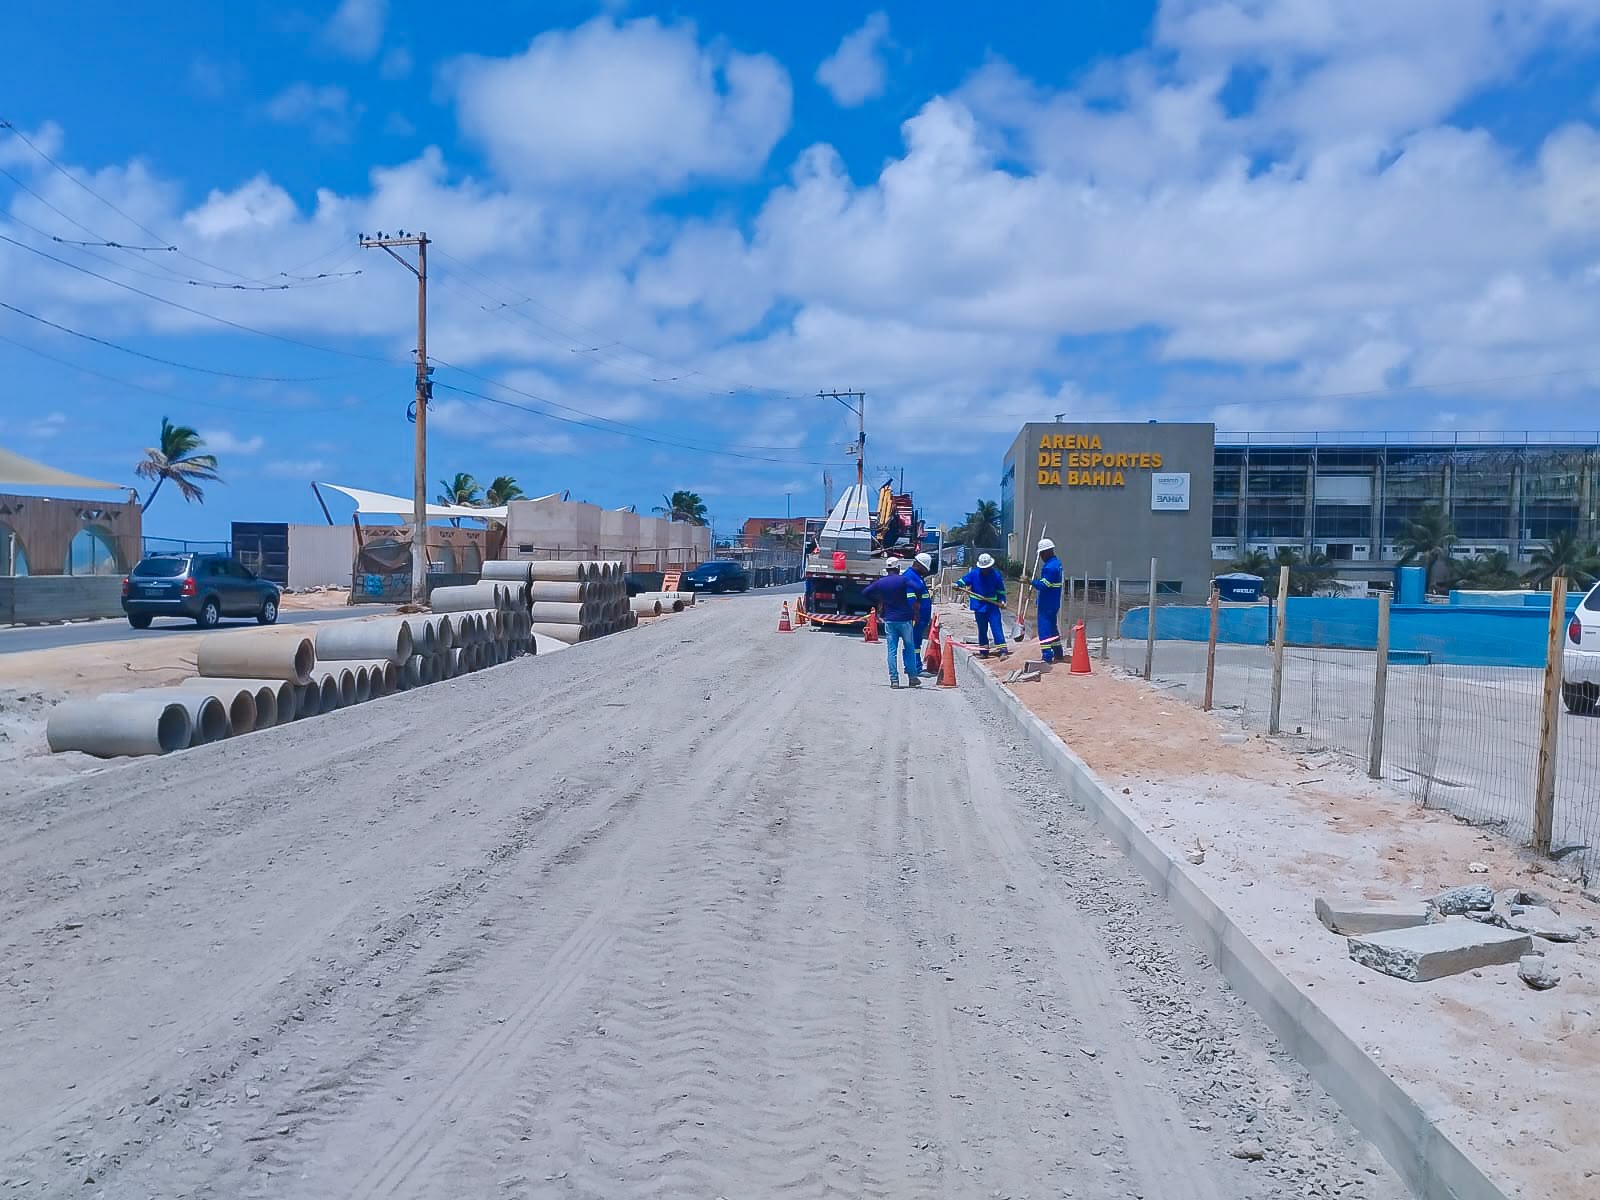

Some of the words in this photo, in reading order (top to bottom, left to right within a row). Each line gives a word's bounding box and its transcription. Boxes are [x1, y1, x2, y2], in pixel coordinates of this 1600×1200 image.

[1039, 434, 1103, 449] ARENA
[1038, 452, 1062, 467] DE
[1068, 452, 1163, 468] ESPORTES
[1037, 470, 1061, 485] DA
[1068, 470, 1125, 486] BAHIA
